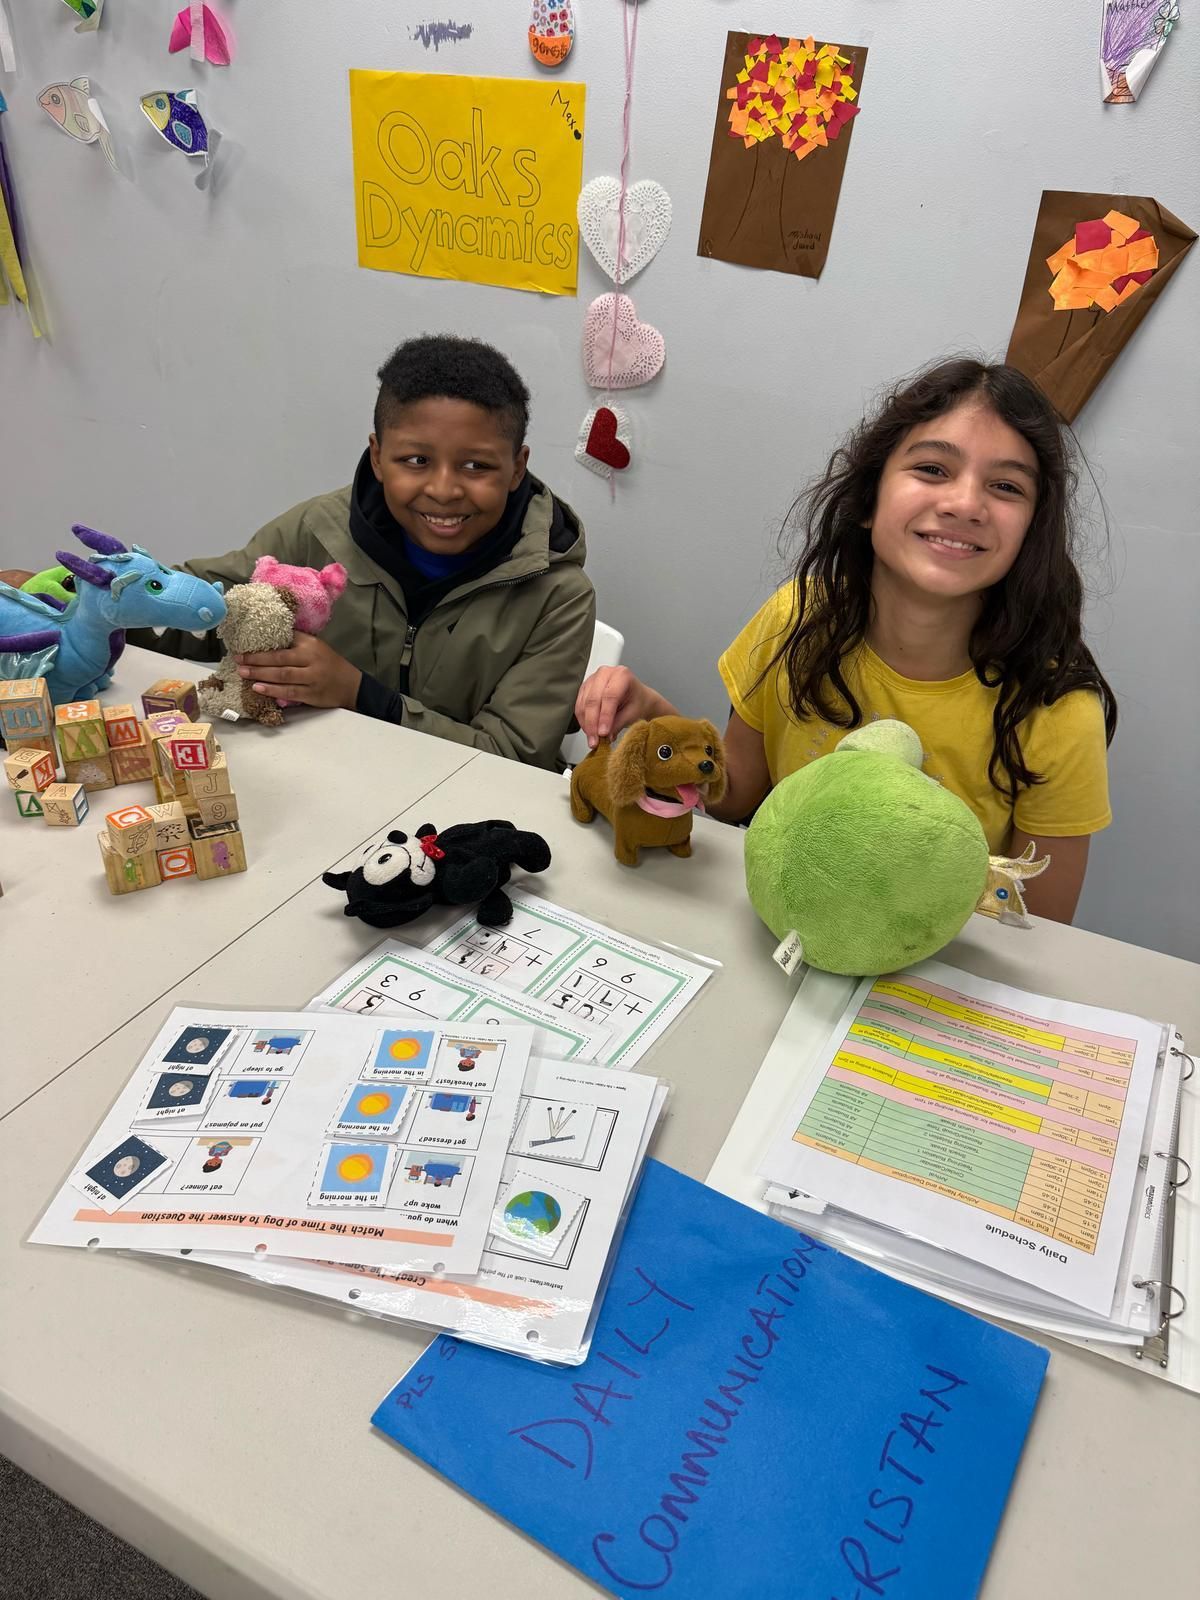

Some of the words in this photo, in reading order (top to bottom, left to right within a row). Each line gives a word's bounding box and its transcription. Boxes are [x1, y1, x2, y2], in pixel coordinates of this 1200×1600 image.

[550, 89, 577, 130] Max
[377, 107, 542, 207] Oaks
[362, 180, 574, 272] Dynamics
[203, 772, 218, 794] J
[211, 801, 227, 821] 9
[523, 928, 540, 939] 7
[592, 958, 607, 968] 6
[380, 974, 398, 988] 3
[620, 973, 636, 984] 9
[409, 989, 426, 1001] 9
[435, 1078, 473, 1087] breakfast?
[156, 1108, 175, 1116] night
[934, 1102, 954, 1113] ending
[954, 1109, 979, 1120] Students
[989, 1121, 1016, 1134] Dismissal
[418, 1136, 452, 1144] dressed?
[453, 1137, 466, 1146] get
[929, 1133, 952, 1145] Rotation
[815, 1142, 838, 1154] Students
[930, 1143, 947, 1152] Break
[954, 1140, 979, 1154] Teaching
[922, 1150, 946, 1162] Rotation
[949, 1149, 966, 1159] Snack
[948, 1158, 974, 1171] Teaching
[892, 1170, 925, 1185] Description
[929, 1172, 948, 1182] Arrival
[84, 1183, 100, 1196] night
[925, 1181, 937, 1189] and
[938, 1185, 956, 1197] Name
[319, 1193, 353, 1201] morning
[354, 1194, 367, 1202] the
[958, 1192, 979, 1205] Activity
[421, 1201, 441, 1210] wake
[141, 1211, 186, 1222] Question
[188, 1213, 205, 1222] the
[208, 1213, 247, 1224] Answer
[250, 1216, 259, 1225] to
[264, 1215, 284, 1227] Day
[424, 1216, 434, 1224] do
[436, 1217, 458, 1226] When
[1019, 1217, 1034, 1227] Time
[287, 1220, 298, 1228] of
[301, 1220, 326, 1232] Time
[330, 1224, 347, 1236] the
[1036, 1223, 1049, 1232] End
[351, 1225, 384, 1238] Match
[985, 1224, 1036, 1250] Schedule
[1058, 1232, 1074, 1245] Time
[1076, 1242, 1090, 1250] Start
[1039, 1245, 1068, 1264] Daily
[528, 1279, 563, 1290] Instructions:
[508, 1266, 695, 1480] DAILY
[396, 1373, 435, 1410] PLS
[592, 1232, 828, 1590] COMMUNICATION
[831, 1364, 968, 1600] RISTAN
